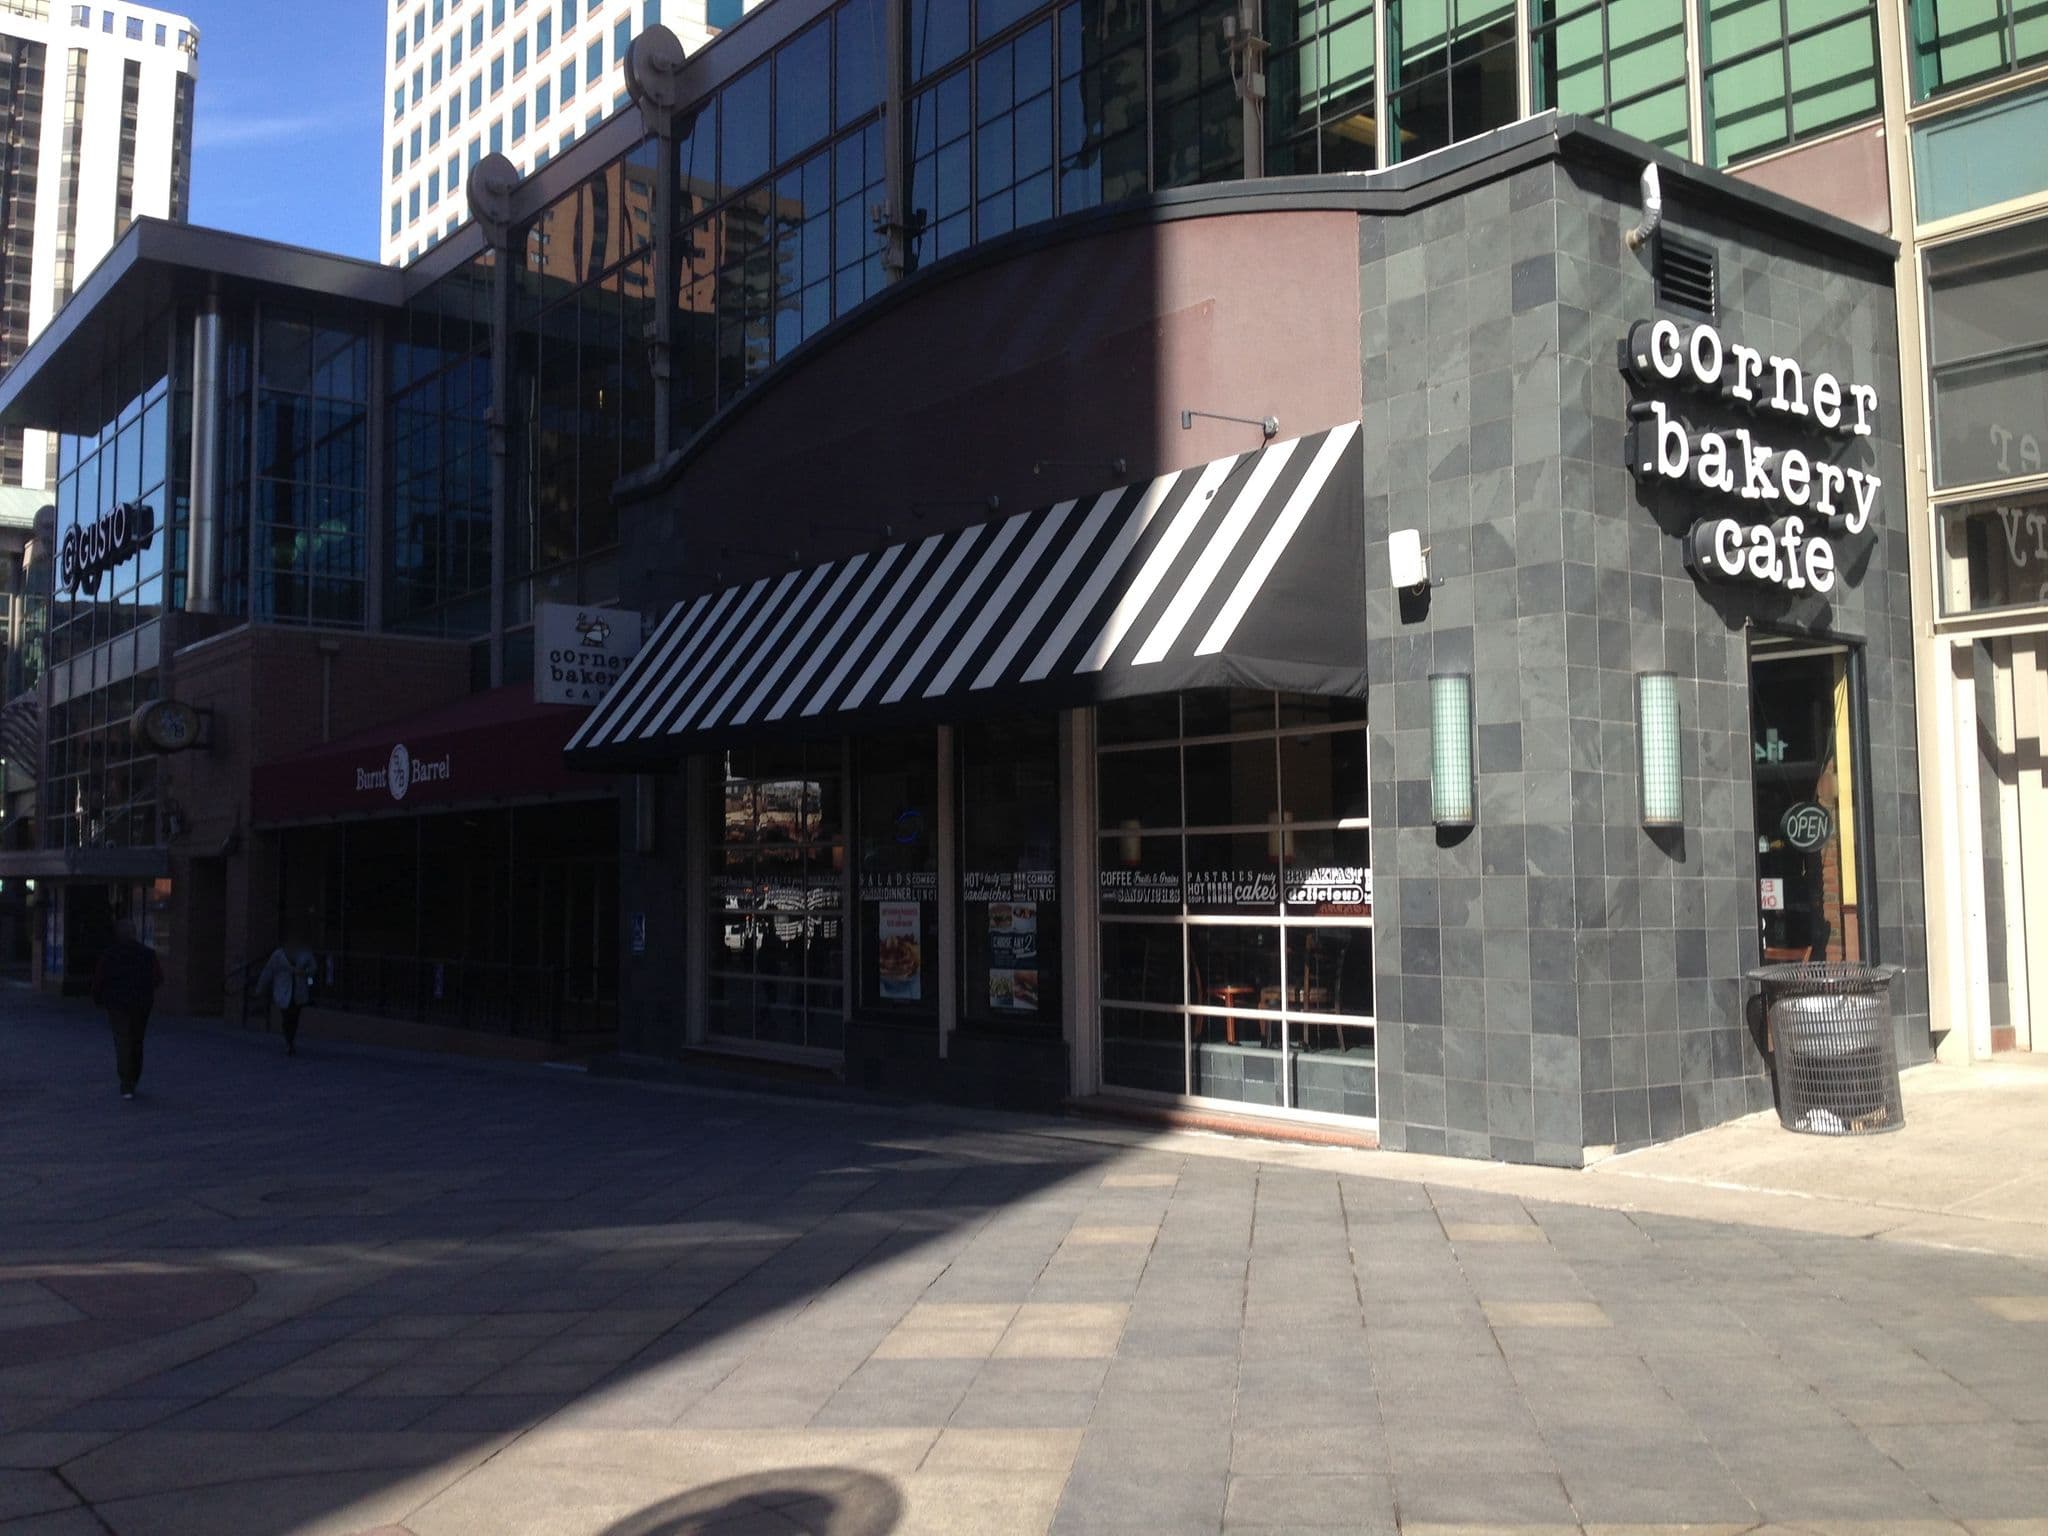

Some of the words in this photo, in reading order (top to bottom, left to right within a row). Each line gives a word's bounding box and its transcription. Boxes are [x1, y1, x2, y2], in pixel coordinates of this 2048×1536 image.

[1651, 320, 1877, 435] corner
[1651, 401, 1881, 534] bakery
[79, 503, 125, 570] GUSTO
[1715, 516, 1834, 592] cafe
[550, 650, 633, 668] corner
[551, 665, 622, 684] baker
[356, 765, 387, 790] Burnt
[411, 753, 450, 783] Barrel
[1786, 814, 1829, 839] OPEN
[963, 872, 980, 887] HOT
[1100, 871, 1132, 886] COFFEE
[1187, 871, 1253, 882] PASTRIES
[1187, 882, 1205, 895] HOT
[1235, 873, 1279, 901] cakes
[1288, 887, 1359, 901] delicious
[1024, 935, 1033, 952] 2
